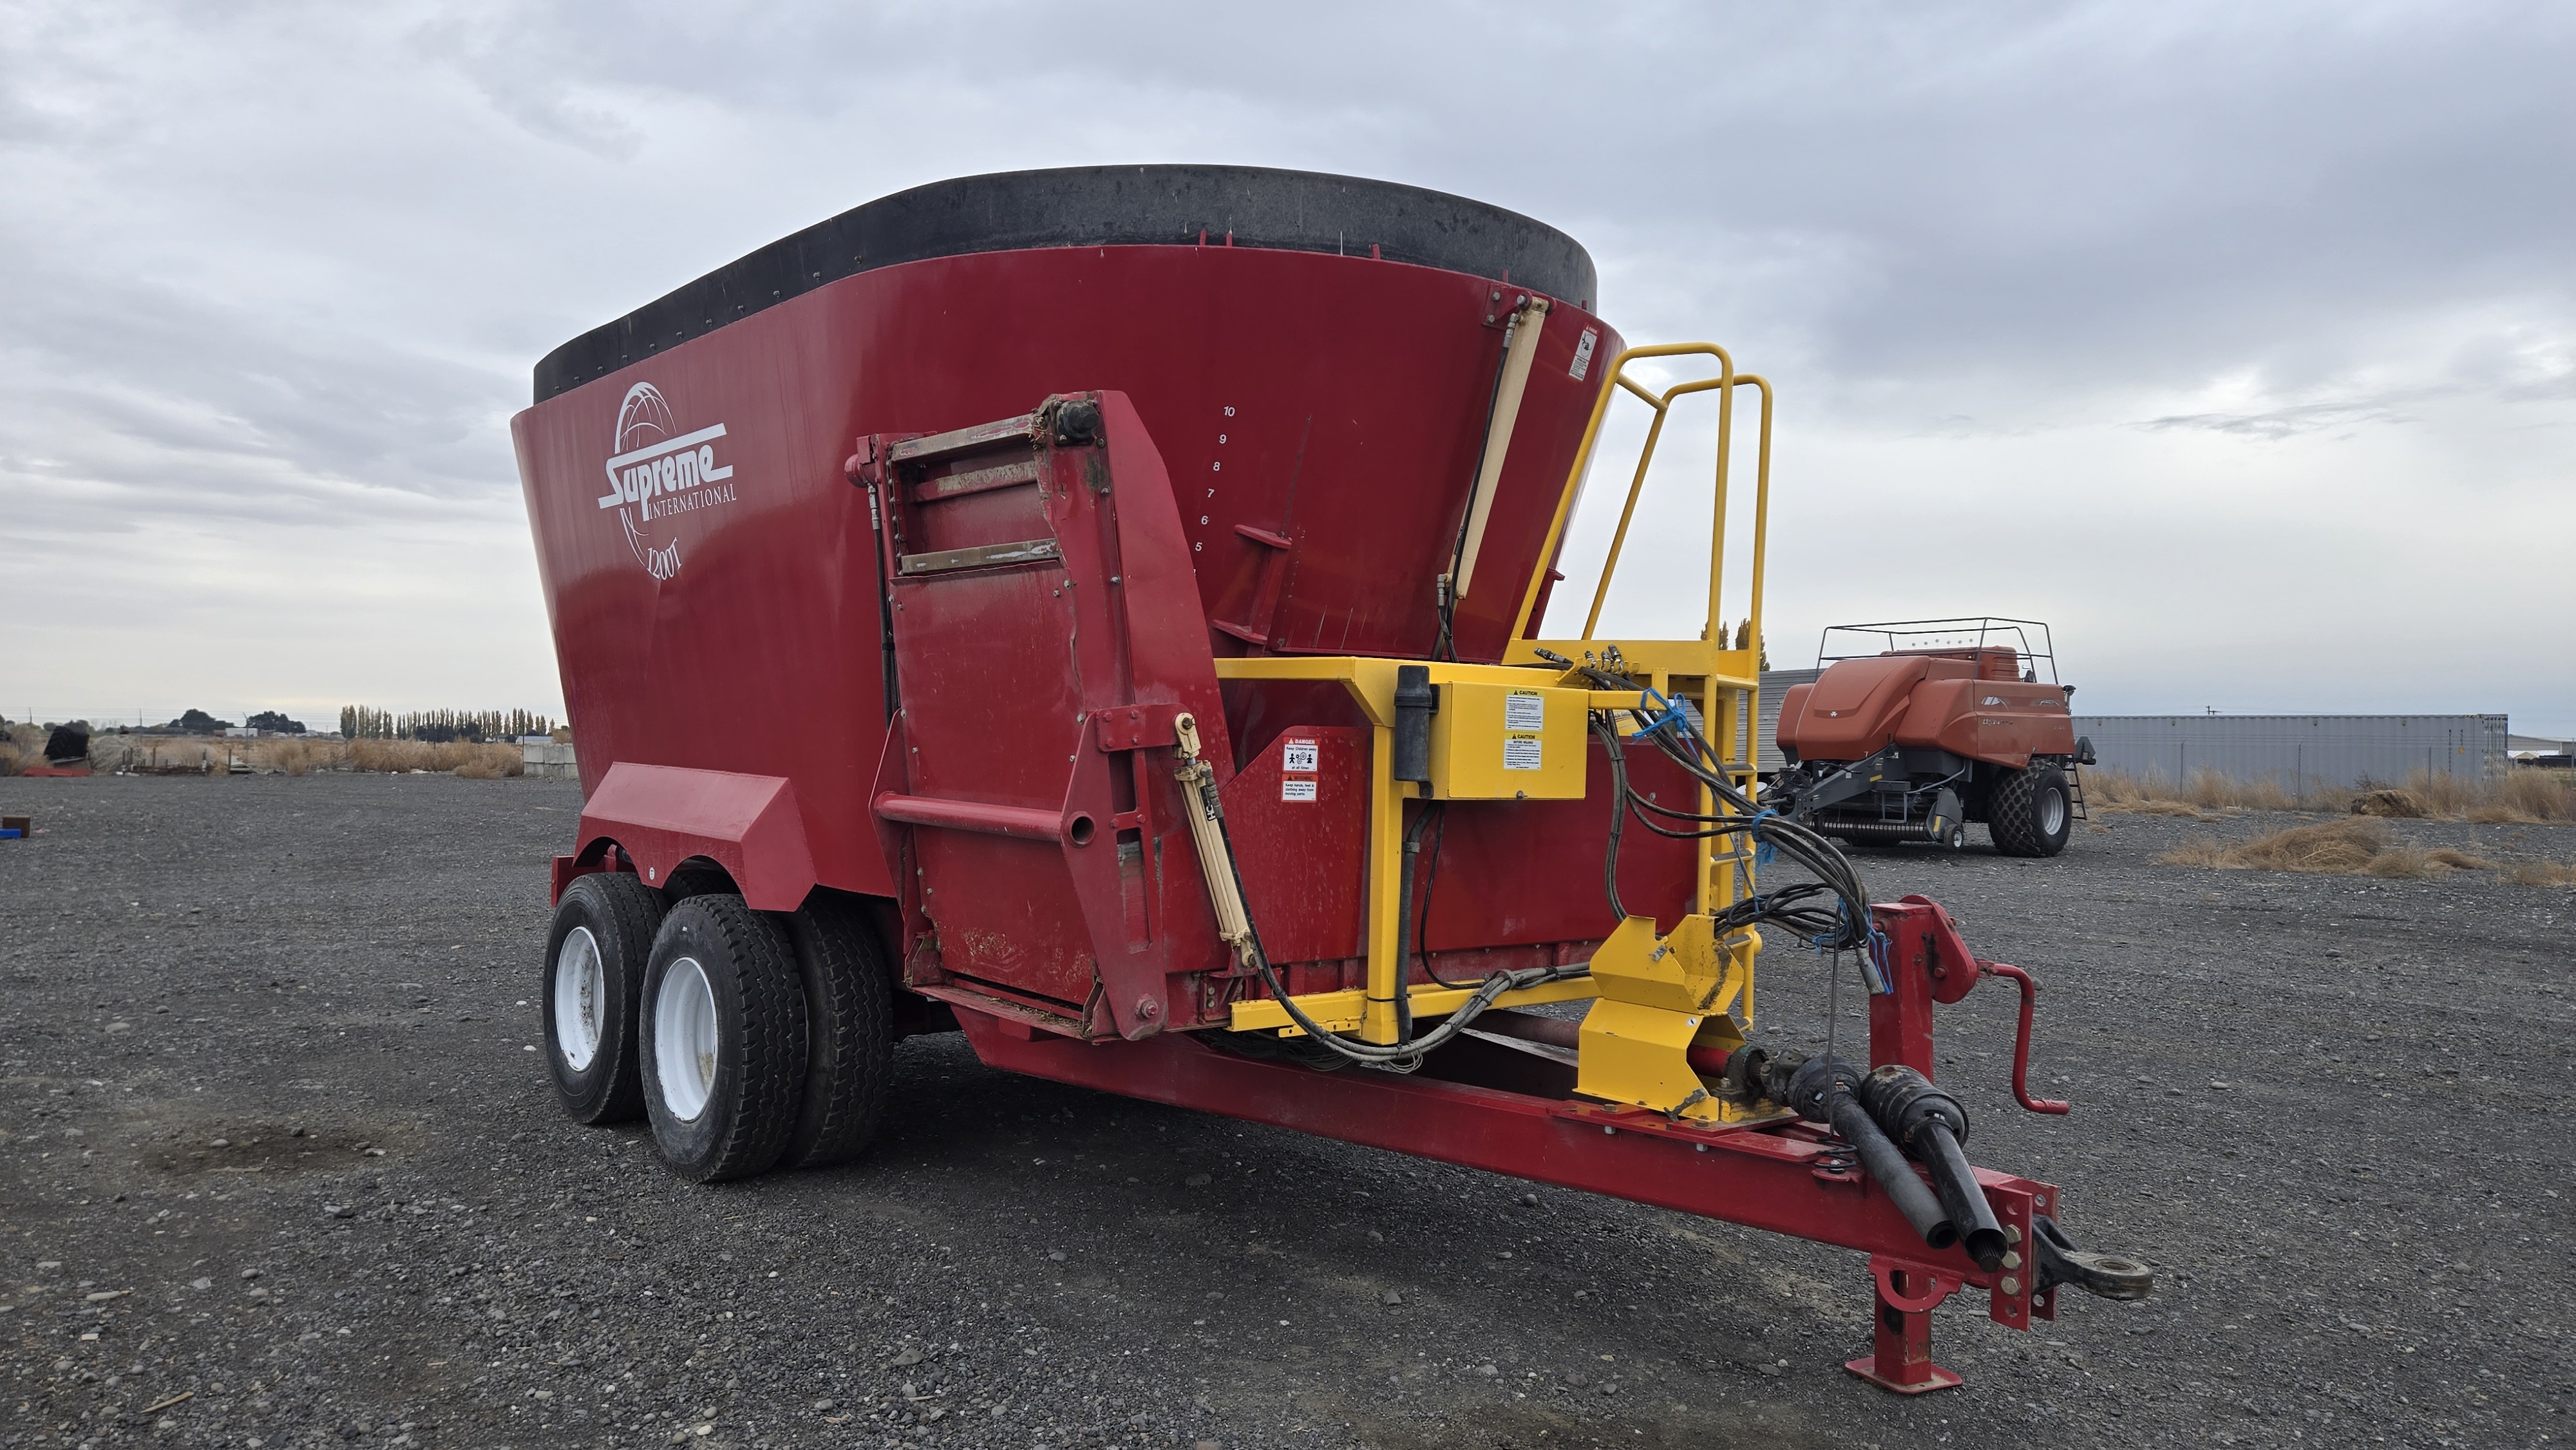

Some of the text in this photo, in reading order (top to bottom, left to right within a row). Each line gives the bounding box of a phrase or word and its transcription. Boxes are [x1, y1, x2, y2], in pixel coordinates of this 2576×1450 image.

[1224, 406, 1235, 417] 10
[1219, 434, 1227, 444] 9
[1213, 462, 1220, 471] 8
[597, 422, 733, 522] Supreme
[1208, 489, 1215, 498] 7
[649, 483, 737, 520] INTERNATIONAL
[1201, 516, 1208, 525] 6
[1195, 542, 1202, 551] 5
[647, 537, 682, 580] 1200T
